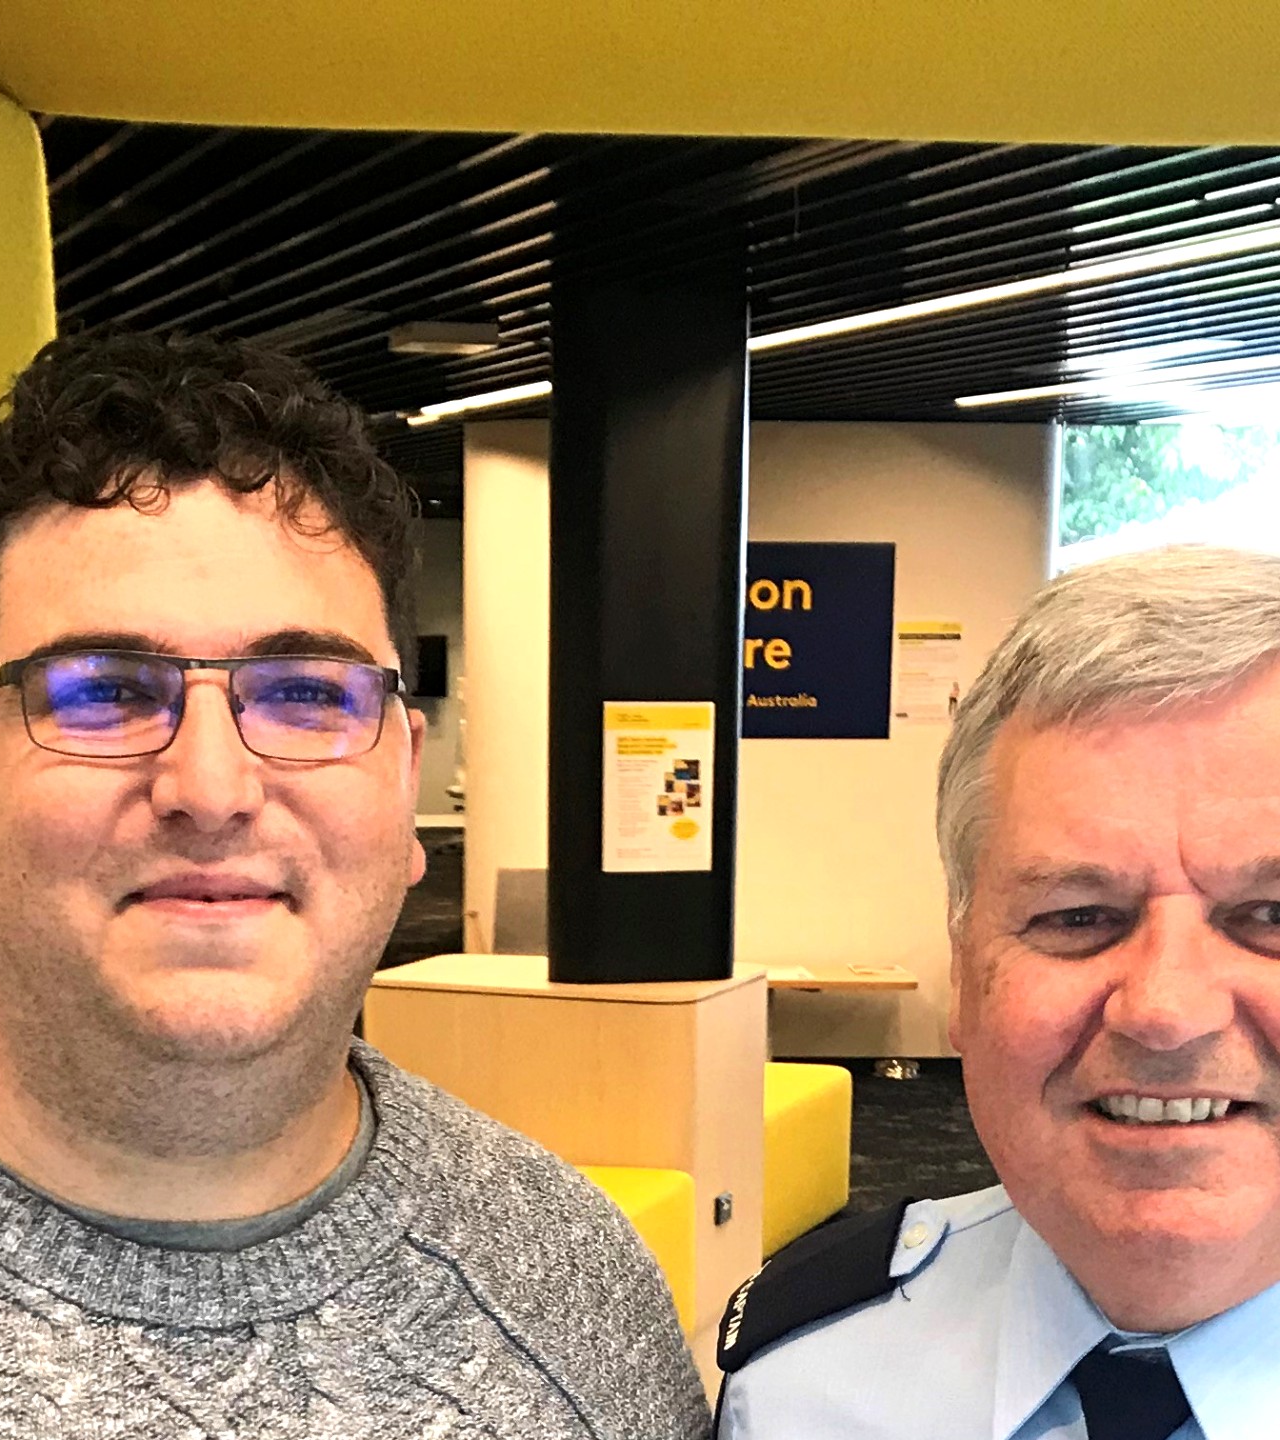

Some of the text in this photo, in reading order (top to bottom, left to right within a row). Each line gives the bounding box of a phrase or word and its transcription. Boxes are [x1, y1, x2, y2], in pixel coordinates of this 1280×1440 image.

[749, 578, 812, 611] on
[743, 637, 792, 670] re
[746, 691, 819, 709] Australia
